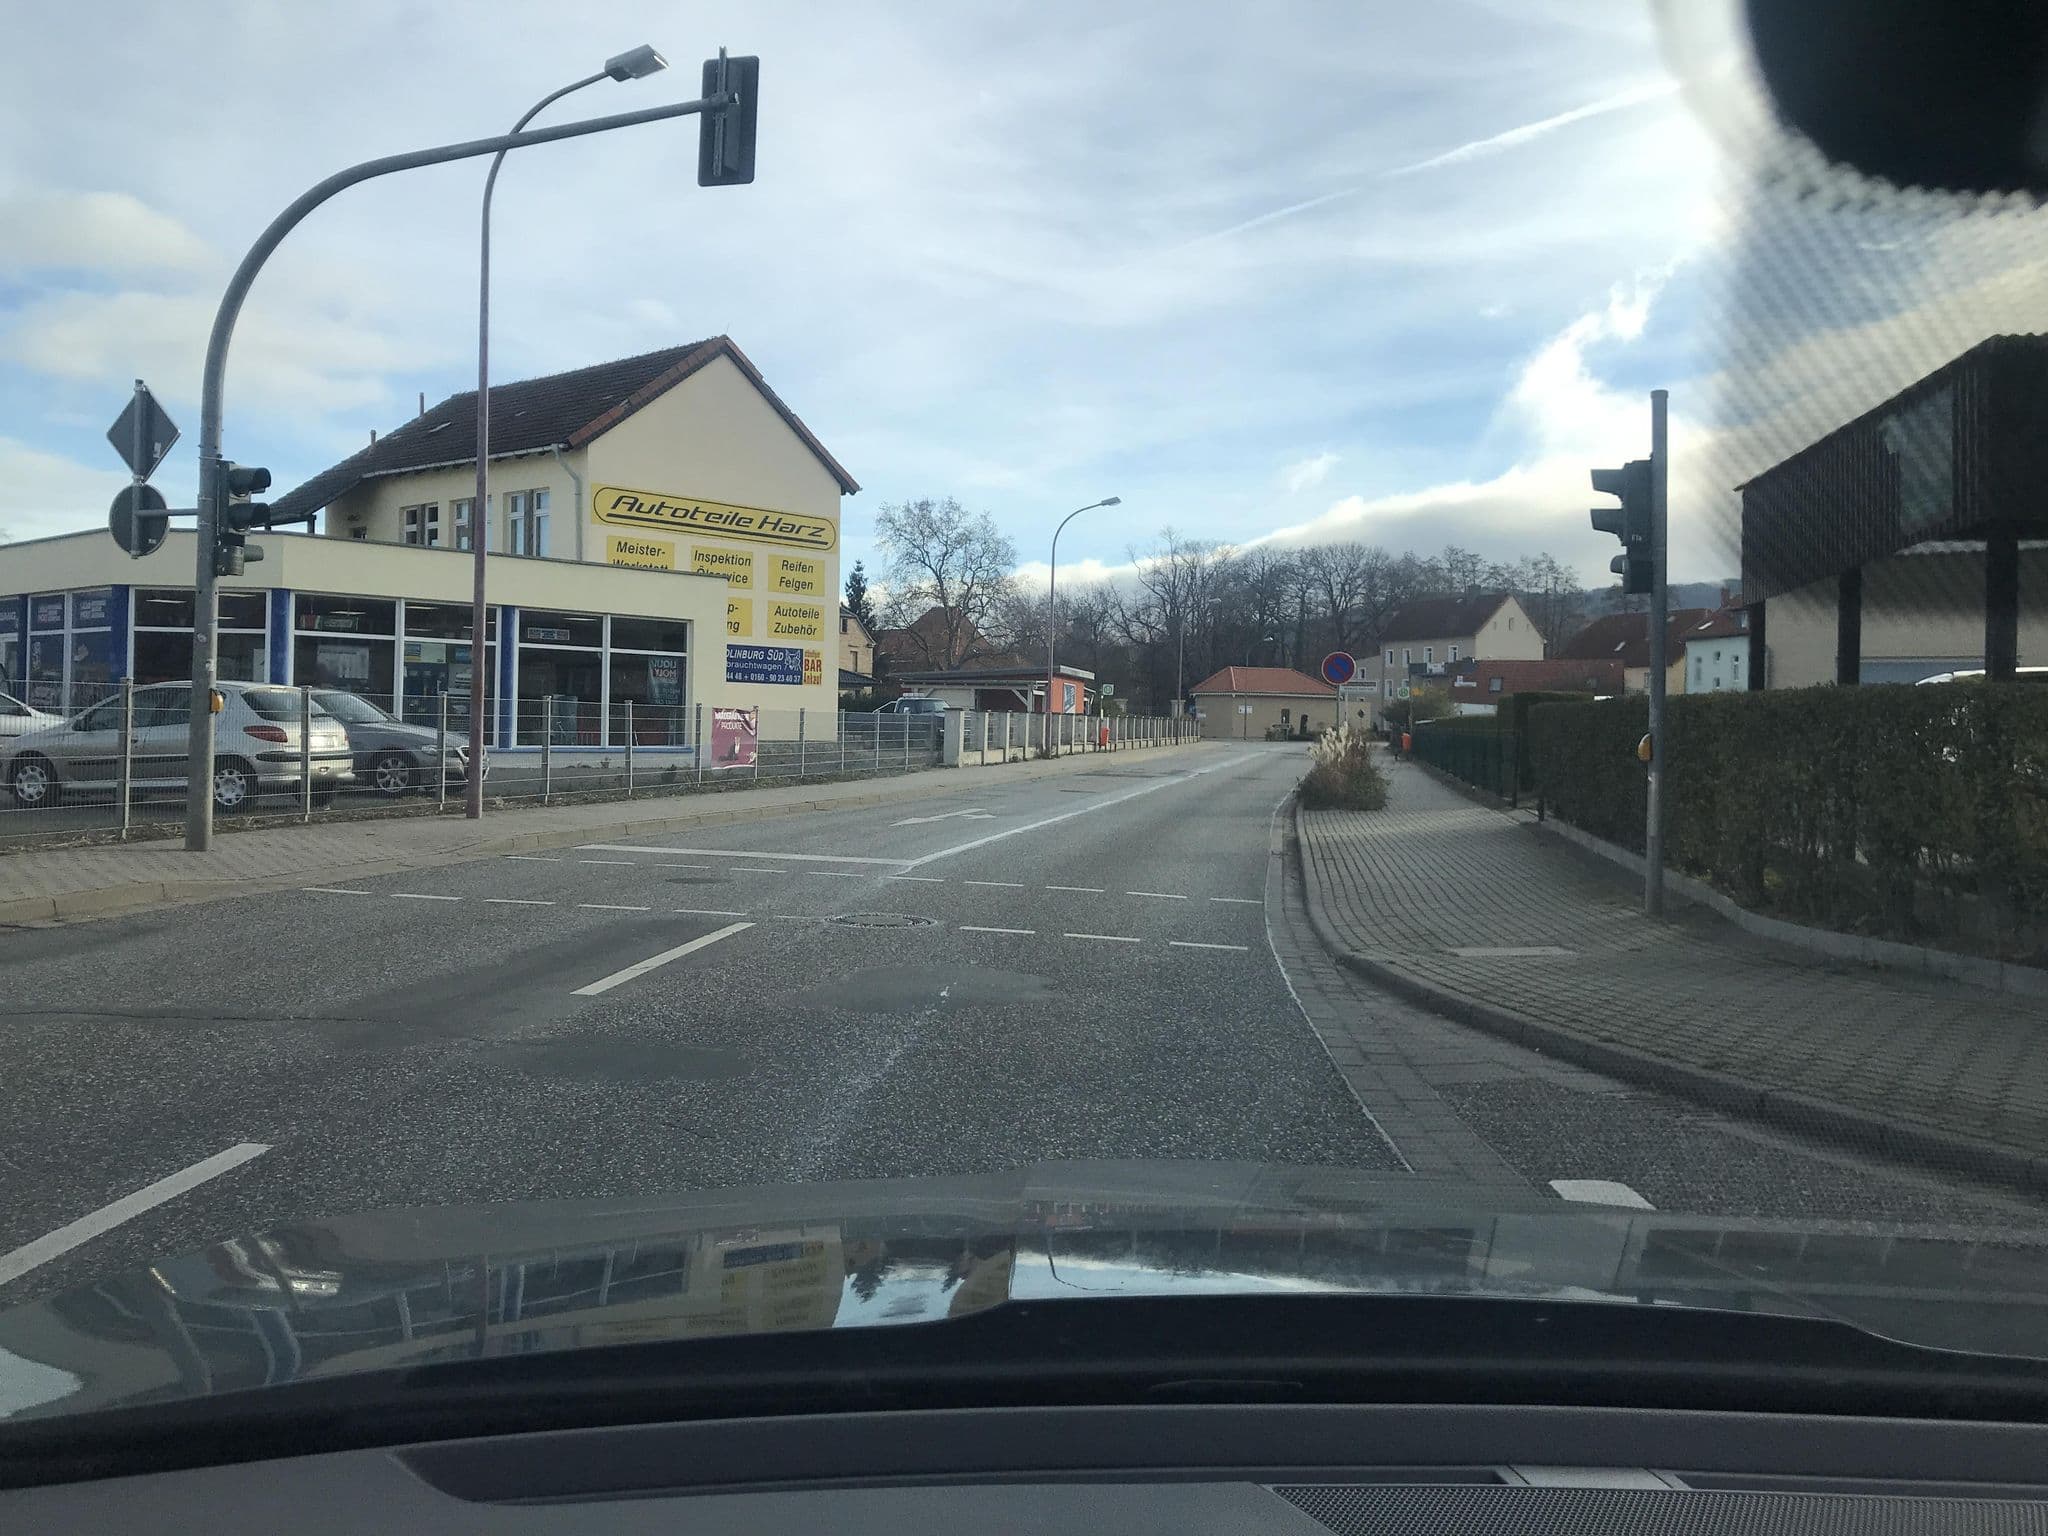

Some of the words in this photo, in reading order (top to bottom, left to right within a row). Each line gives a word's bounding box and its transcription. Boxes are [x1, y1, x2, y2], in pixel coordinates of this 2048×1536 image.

[611, 495, 753, 527] Autoteile
[758, 515, 826, 537] Harz
[616, 541, 666, 557] Meister-
[694, 550, 751, 567] Inspektion
[781, 560, 814, 573] Reifen
[779, 577, 813, 591] Felgen
[774, 606, 820, 619] Autoteile
[774, 622, 817, 635] Zubehör
[767, 649, 784, 661] SÜD
[804, 659, 822, 672] BAR
